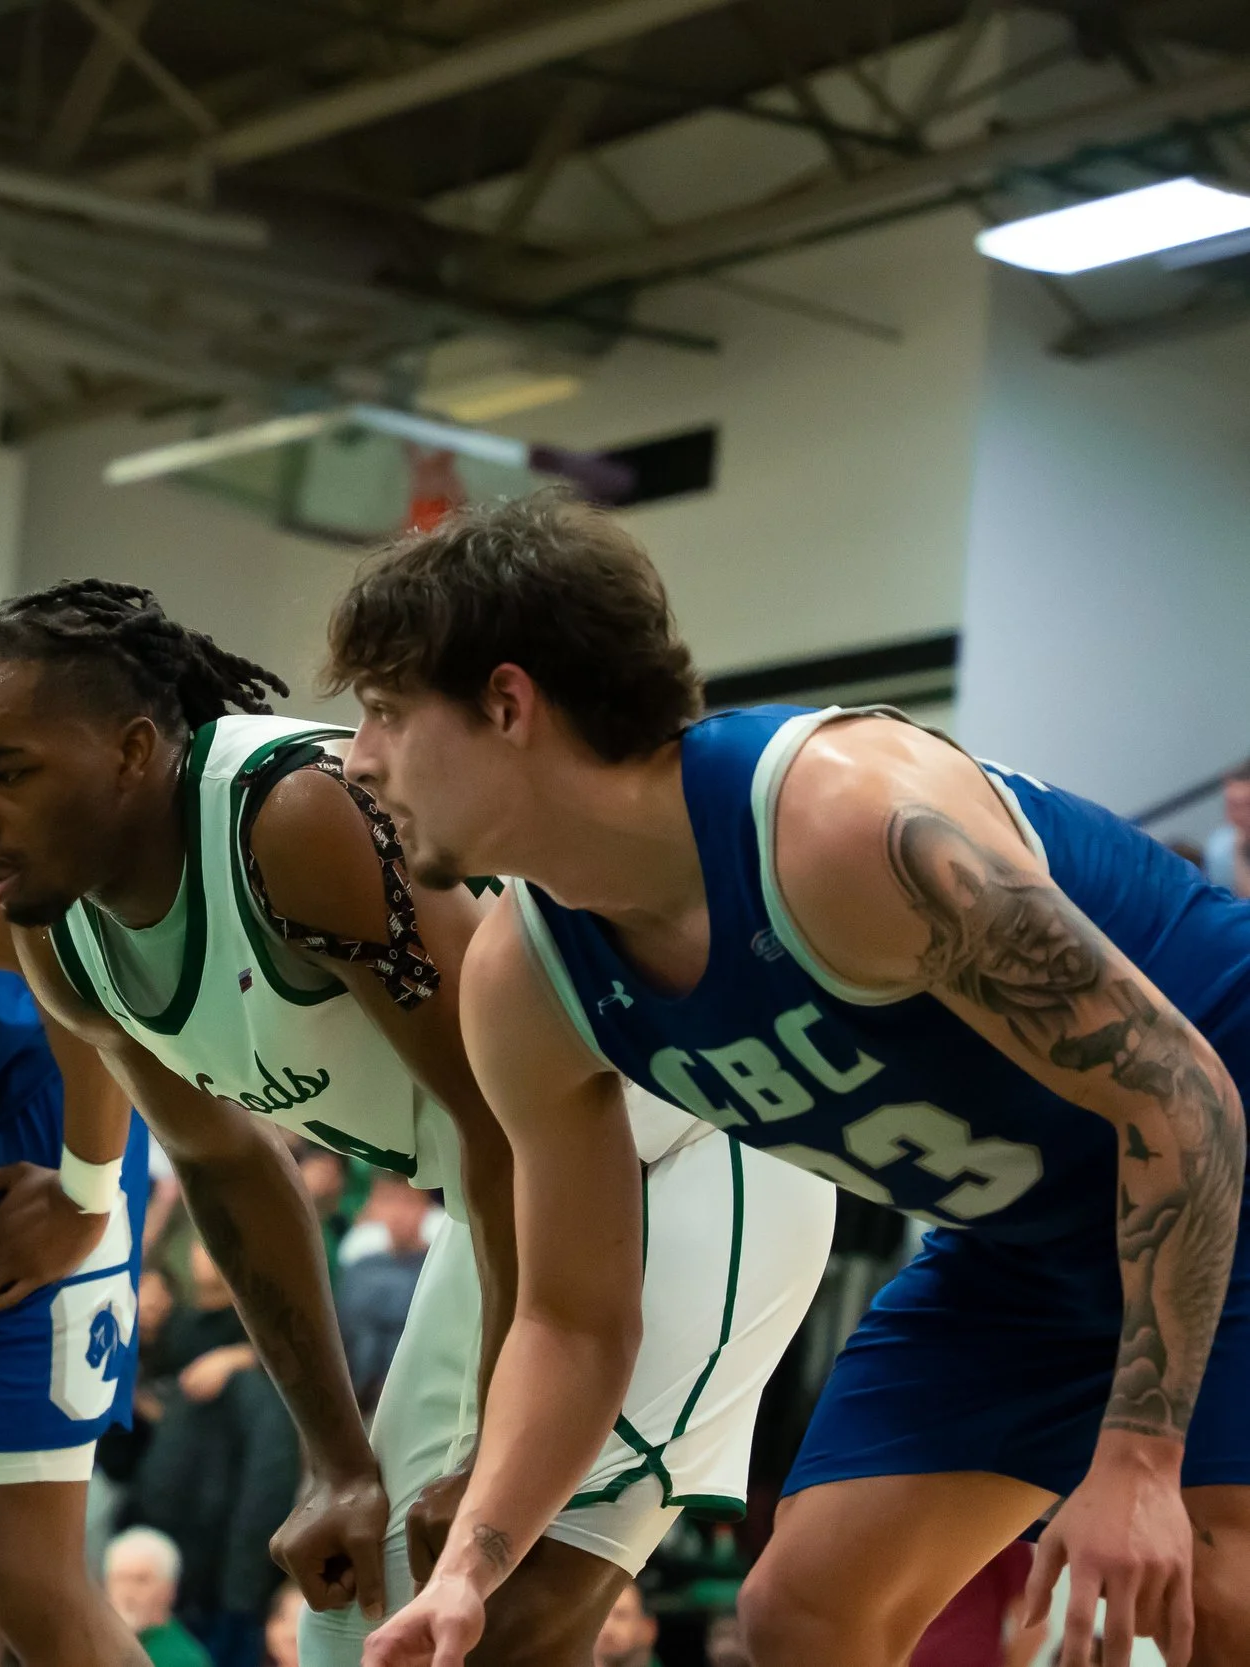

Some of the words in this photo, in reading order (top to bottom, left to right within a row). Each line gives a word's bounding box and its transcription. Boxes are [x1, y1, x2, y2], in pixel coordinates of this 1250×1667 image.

[373, 823, 390, 849] TAPE
[190, 1050, 330, 1114] ods
[650, 1002, 885, 1130] CBC
[758, 1101, 1044, 1230] 3
